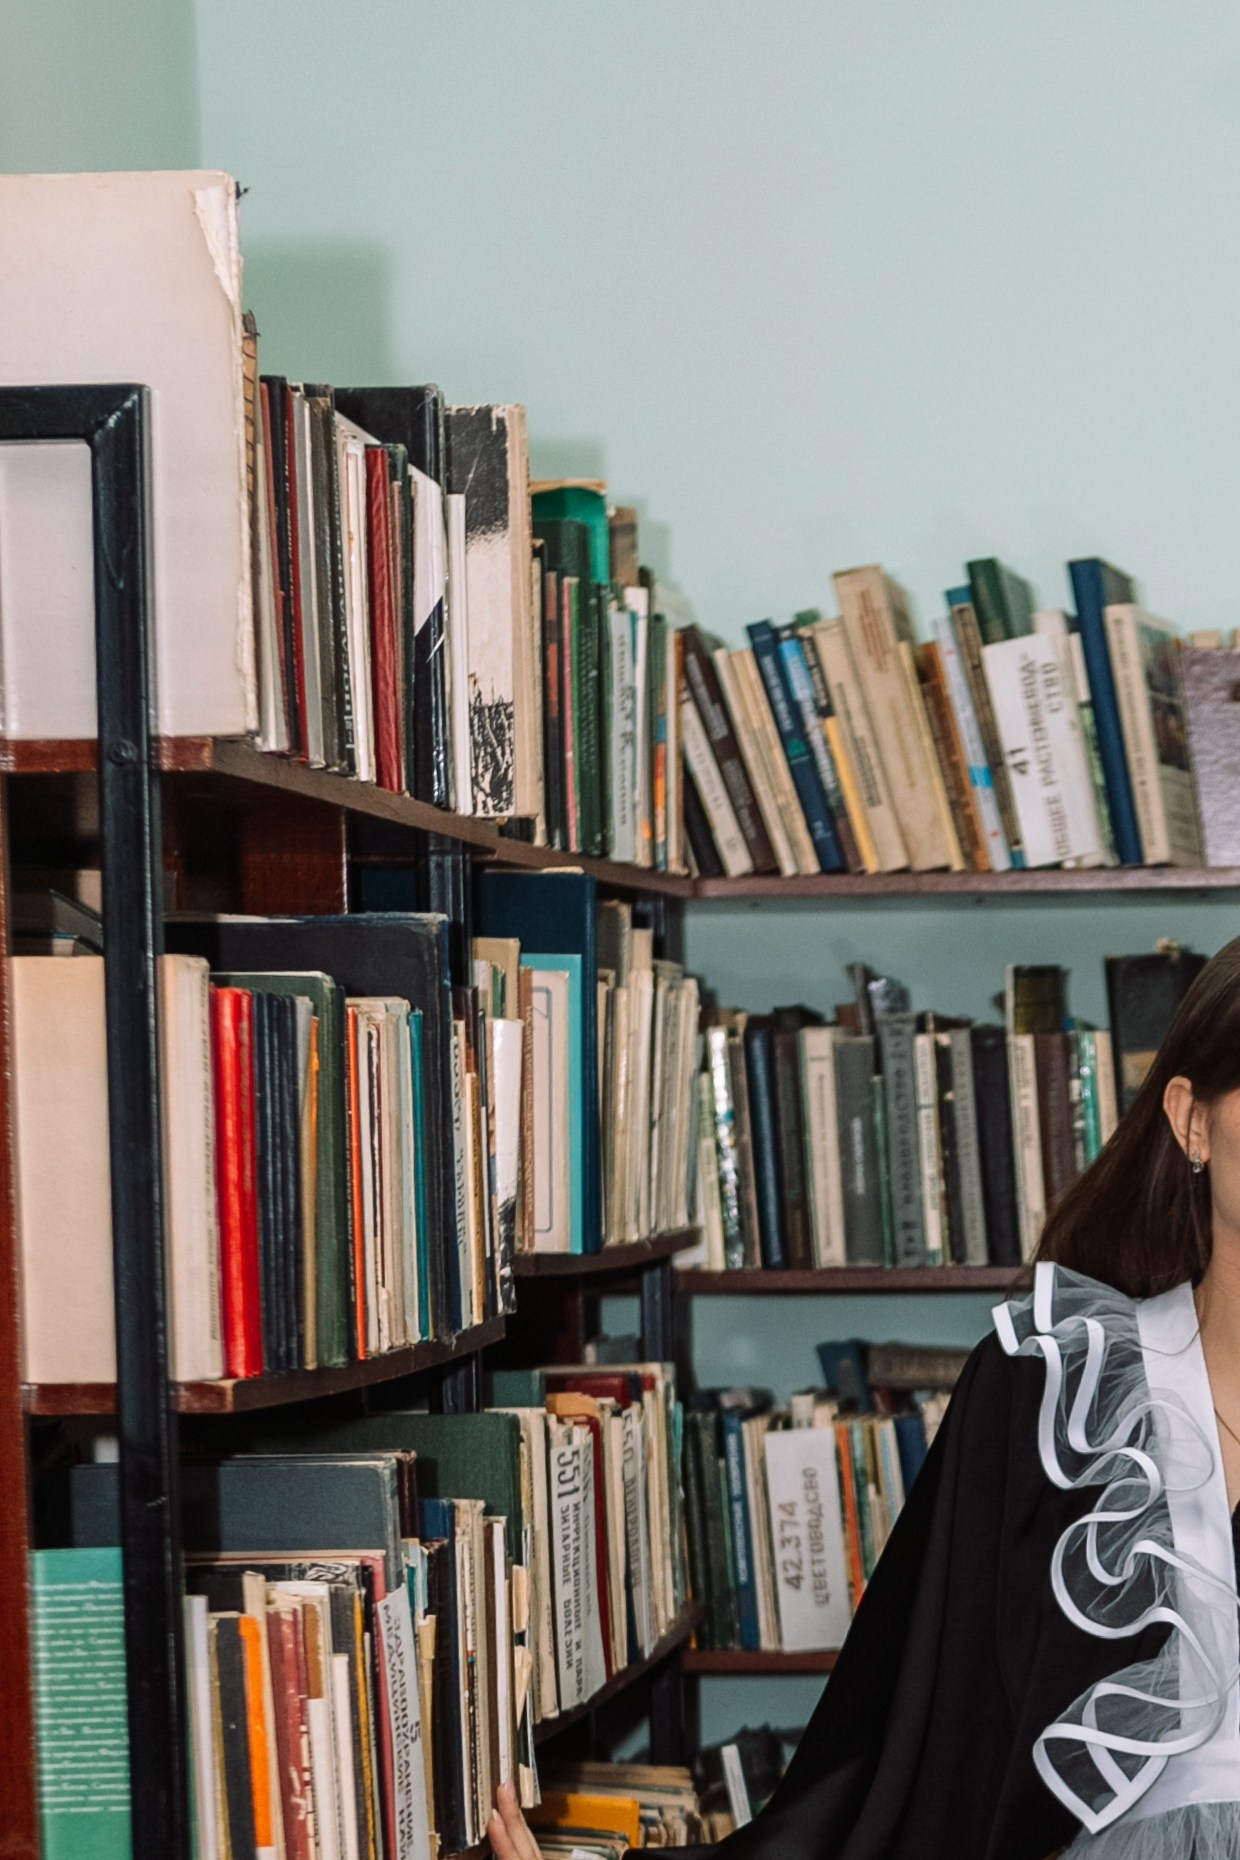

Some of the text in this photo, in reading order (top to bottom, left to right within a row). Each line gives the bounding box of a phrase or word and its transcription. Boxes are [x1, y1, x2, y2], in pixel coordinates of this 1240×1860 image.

[1041, 662, 1063, 713] СТВО
[1007, 746, 1030, 776] 41
[1041, 794, 1071, 857] ОБЩЕЕ
[556, 1449, 582, 1498] 551
[732, 1500, 748, 1584] КОМПЛЕКСНЫЕ
[778, 1500, 804, 1591] 42.374
[560, 1505, 574, 1670] ЗИТАРНЫЕ БОЛЕЗНИ
[573, 1641, 582, 1651] И
[383, 1604, 406, 1793] МЕДИЦИНСКИЕ
[409, 1720, 422, 1745] 5
